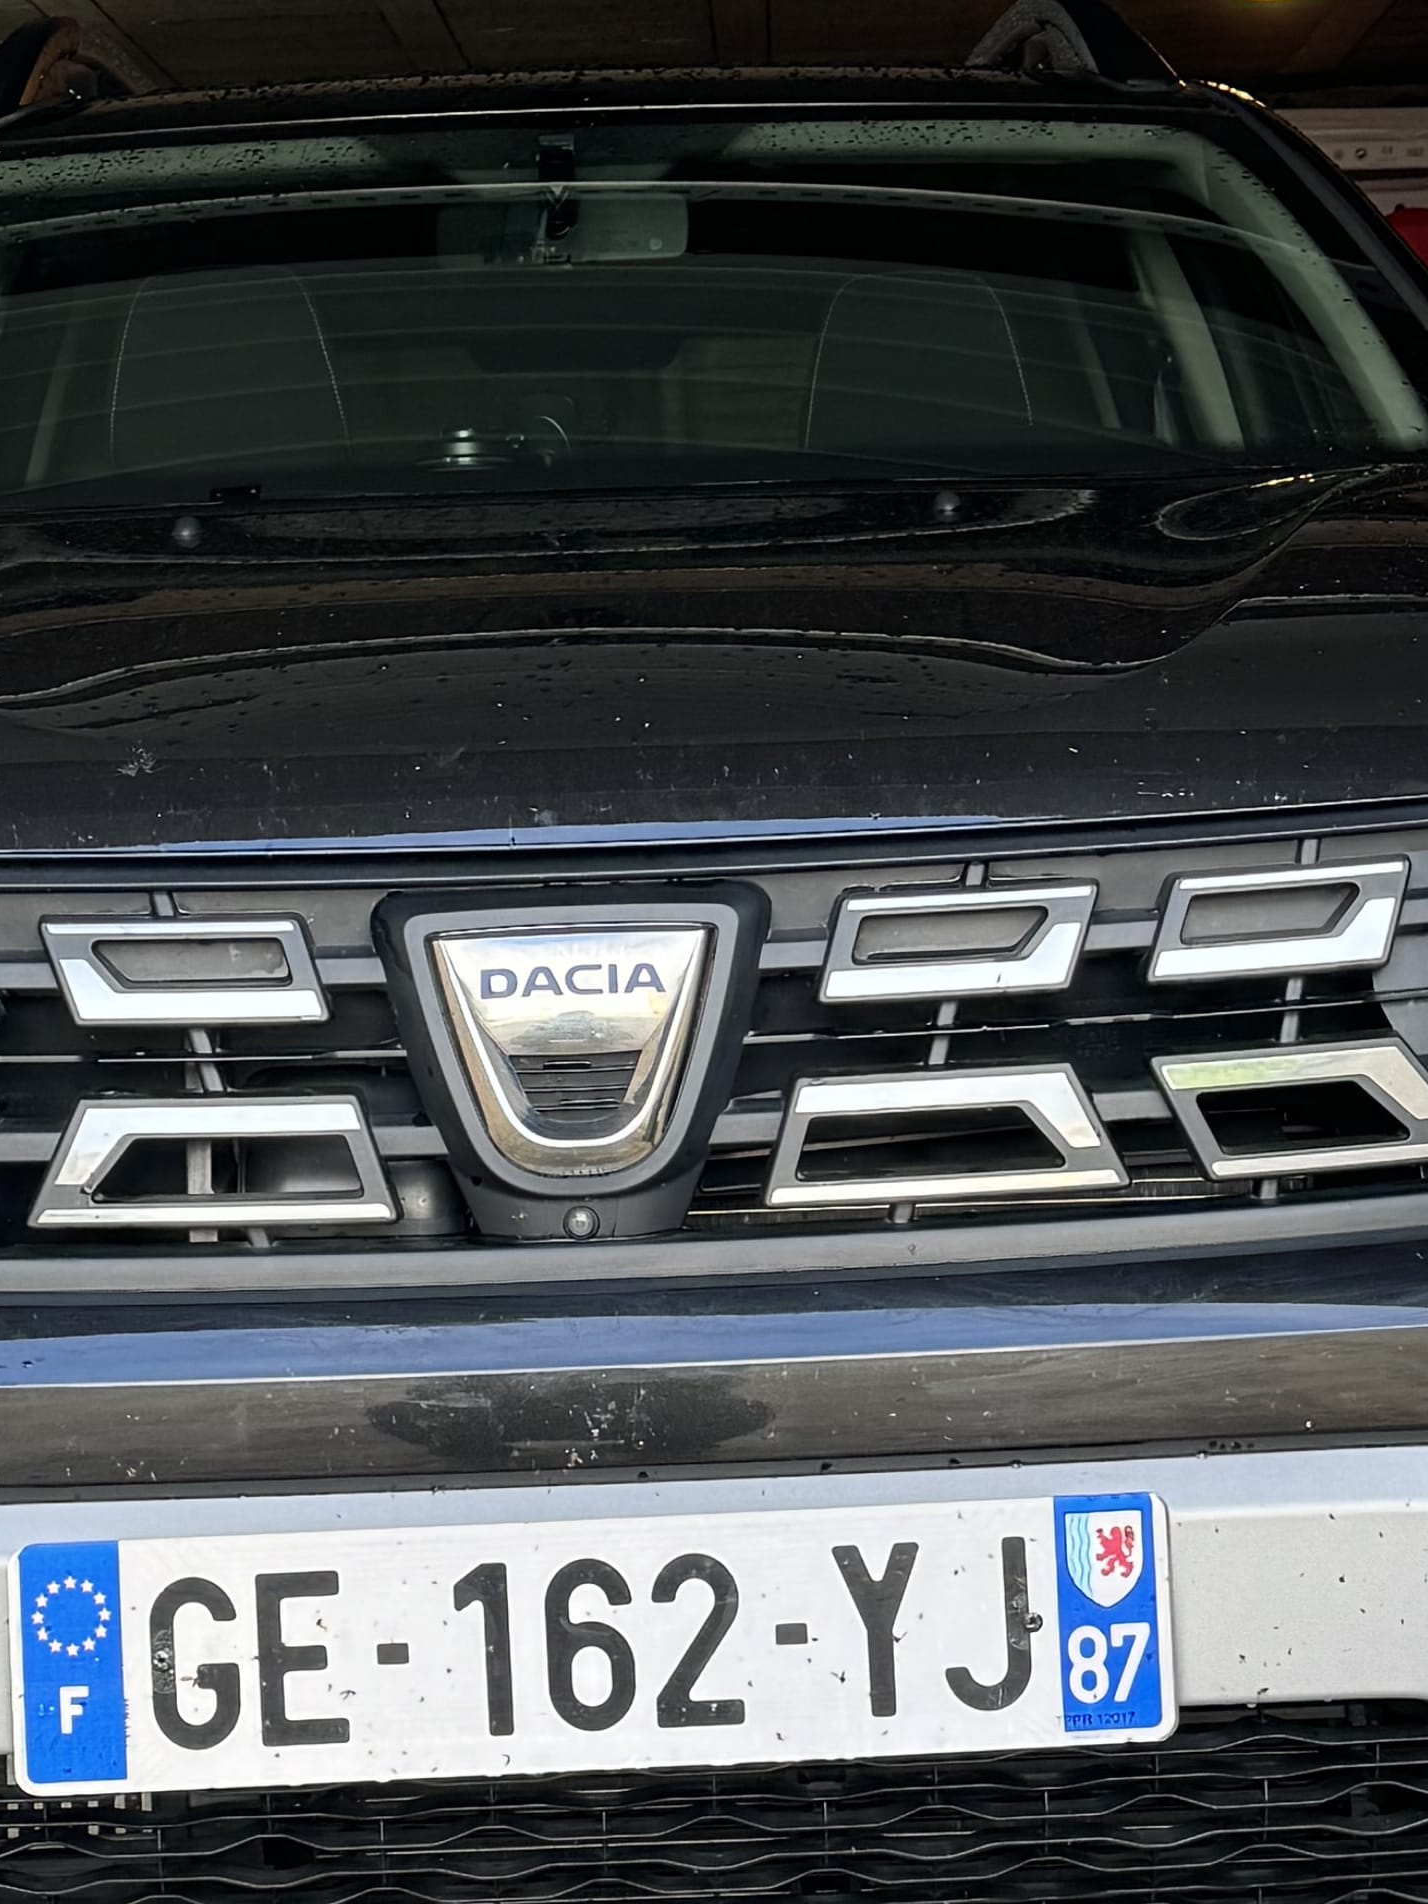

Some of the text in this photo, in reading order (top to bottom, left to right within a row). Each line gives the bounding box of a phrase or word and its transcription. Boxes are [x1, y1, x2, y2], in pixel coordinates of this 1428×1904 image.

[481, 963, 666, 999] DACIA
[150, 1536, 1033, 1751] GE-162-YJ
[1067, 1622, 1151, 1704] 87
[59, 1685, 90, 1735] F
